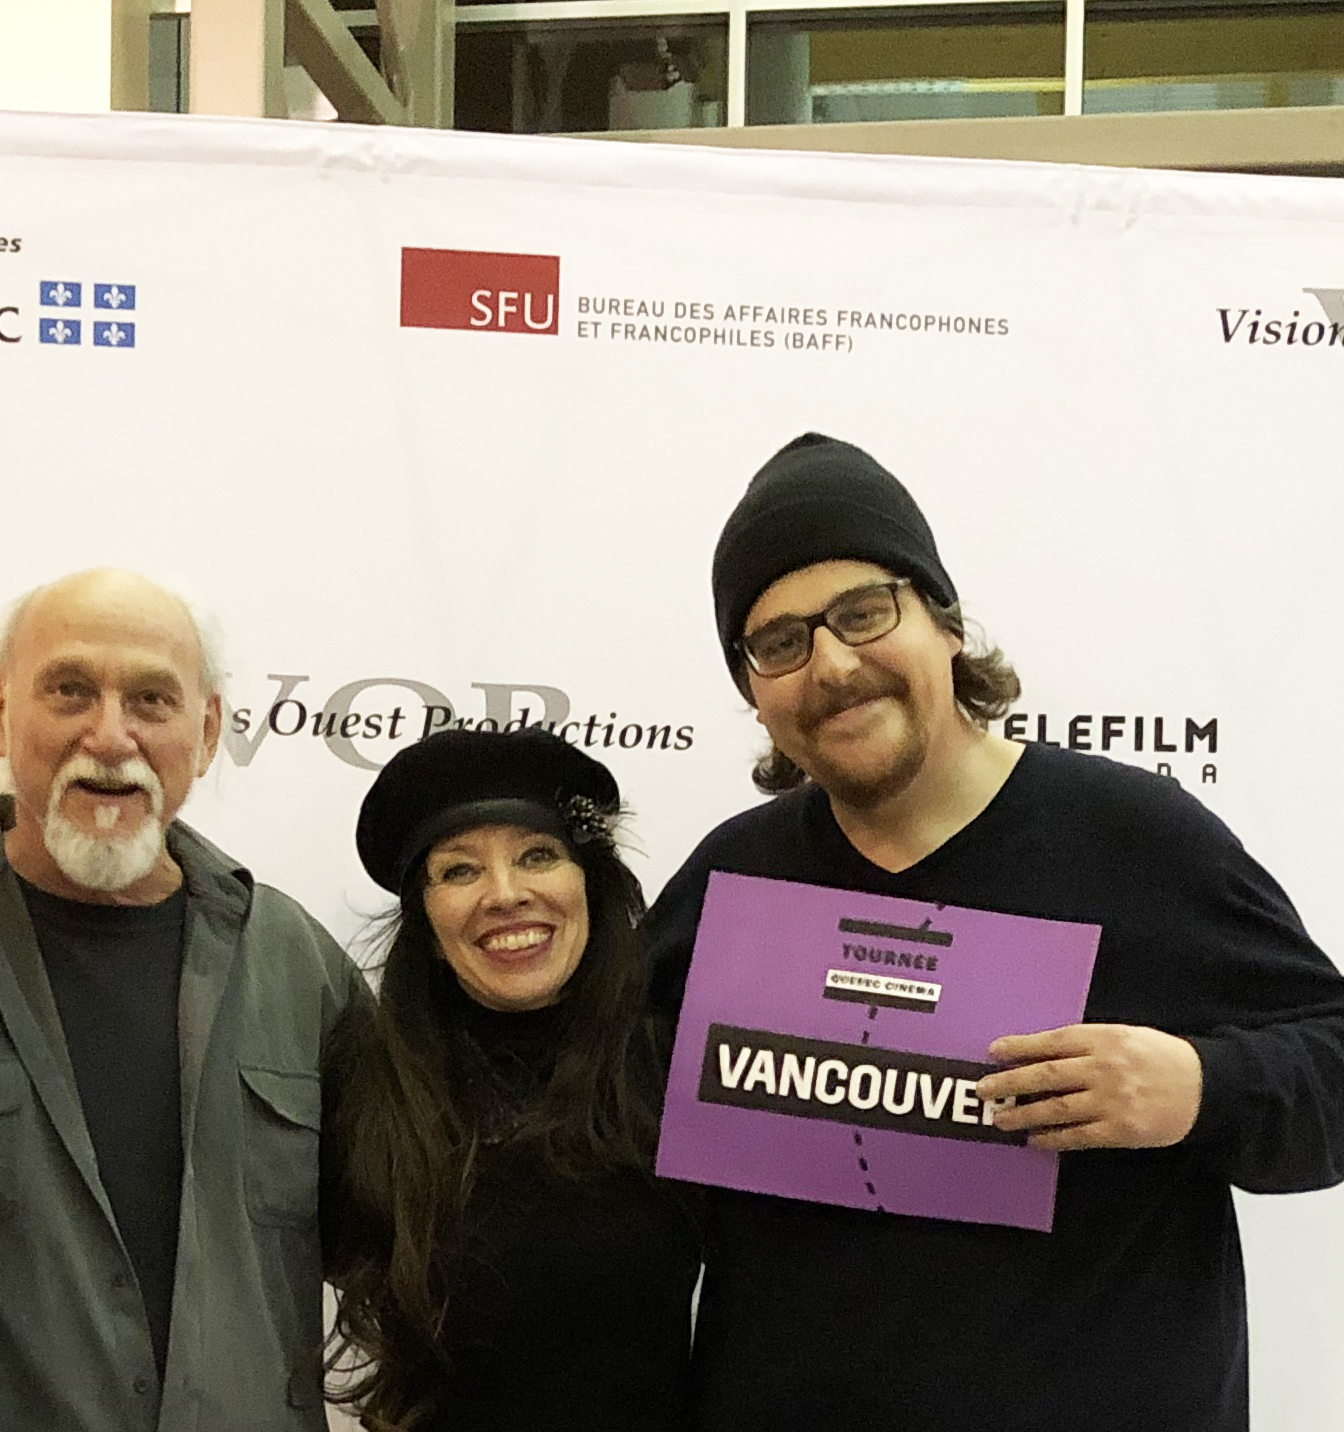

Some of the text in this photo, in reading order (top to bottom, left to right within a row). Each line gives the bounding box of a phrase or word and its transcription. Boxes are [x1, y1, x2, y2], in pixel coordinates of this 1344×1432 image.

[470, 289, 555, 330] SFU
[577, 296, 1010, 337] BUREAU DES AFFAIRES FRANCOPHONES
[577, 321, 854, 354] ET FRANCOPHILES (BAFF)
[268, 698, 407, 740] Ouest
[1004, 714, 1218, 755] ELEFILM
